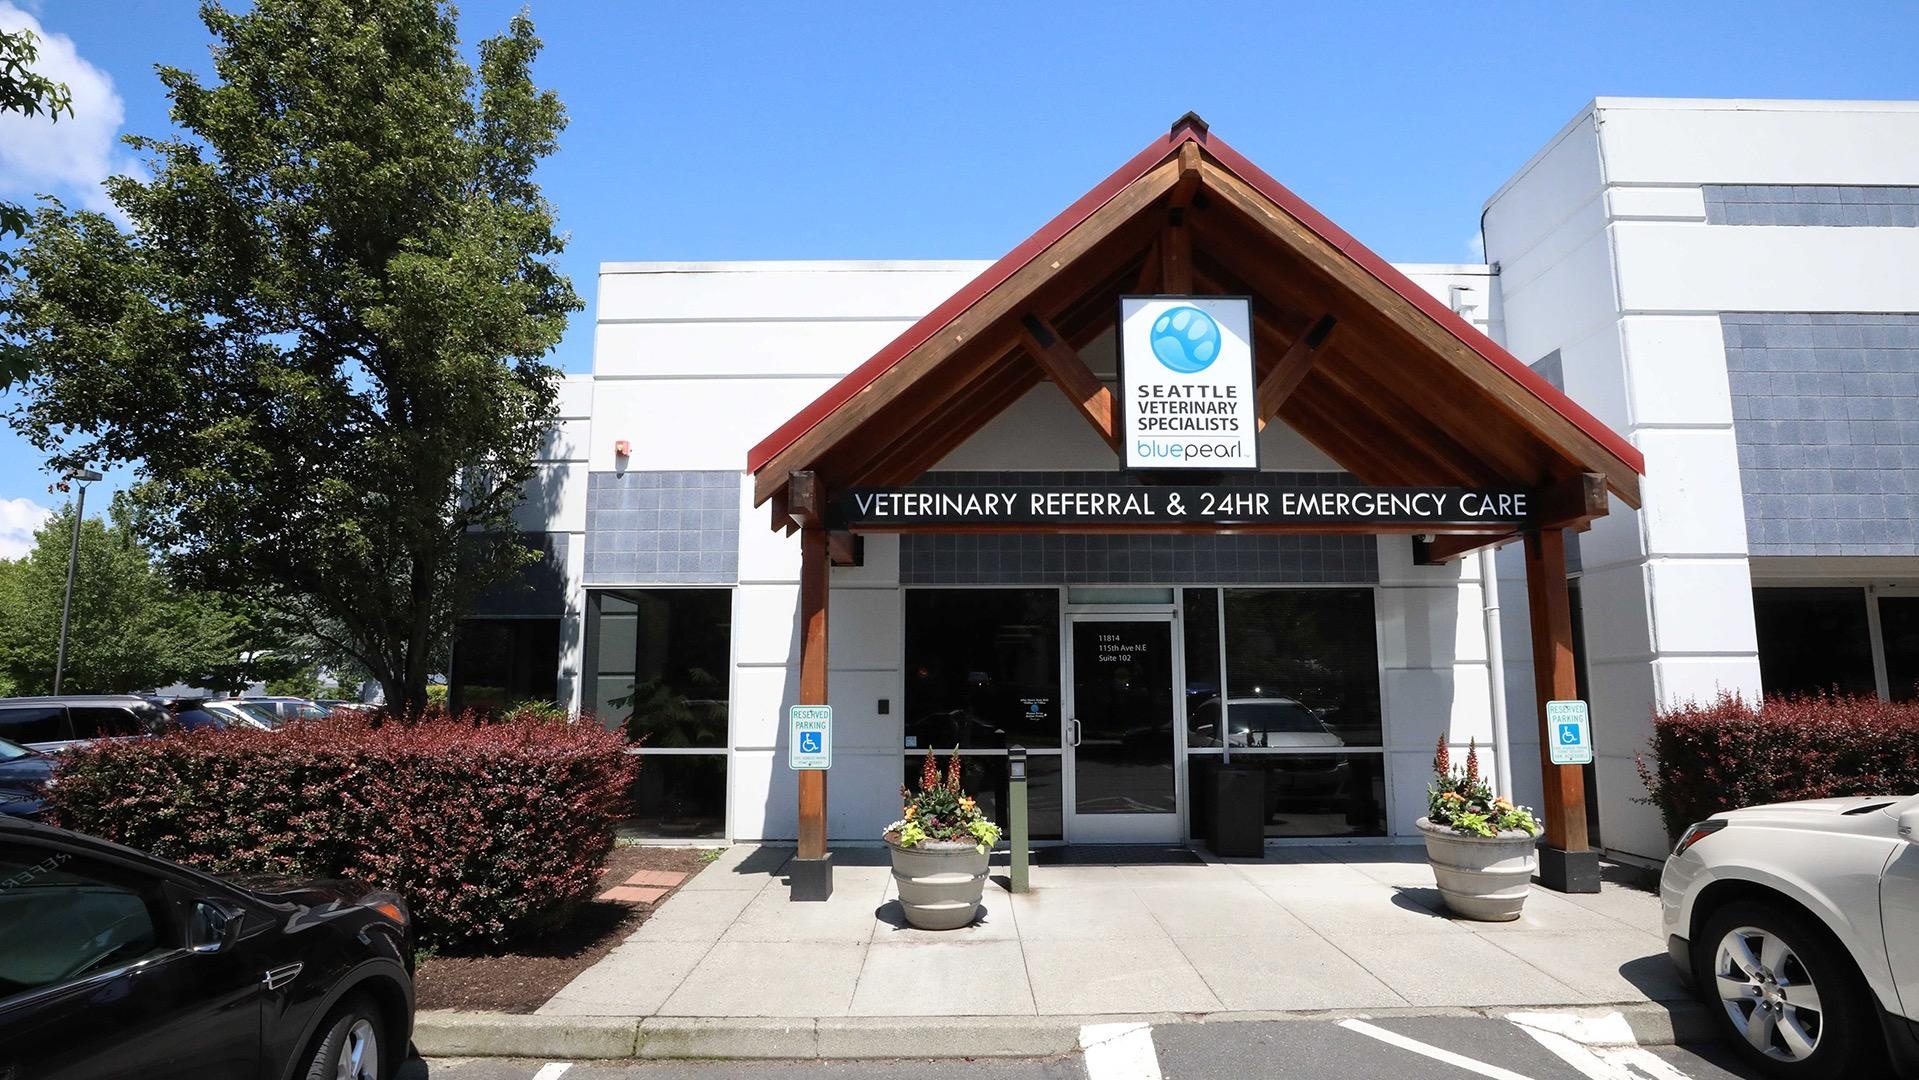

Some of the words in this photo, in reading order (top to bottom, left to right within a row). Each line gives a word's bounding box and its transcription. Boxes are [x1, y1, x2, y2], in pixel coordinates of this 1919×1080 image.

[1138, 385, 1237, 398] SEATTLE
[1138, 401, 1237, 414] VETERINARY
[1138, 417, 1239, 431] SPECIALISTS
[1137, 440, 1241, 461] bluepearl
[855, 493, 1018, 516] VETERINARY
[1031, 493, 1155, 515] REFERRAL
[1166, 492, 1187, 516] &
[1200, 493, 1270, 516] 24HR
[1282, 493, 1447, 516] EMERGENCY
[1459, 493, 1527, 516] CARE
[1099, 644, 1120, 652] 115th
[1120, 644, 1134, 652] Ave
[1099, 654, 1117, 662] Suite
[1118, 654, 1131, 662] 102
[1550, 705, 1584, 713] RESERVED
[794, 711, 828, 719] RESERVED
[1552, 714, 1584, 723] PARKING
[796, 721, 826, 729] PARKING
